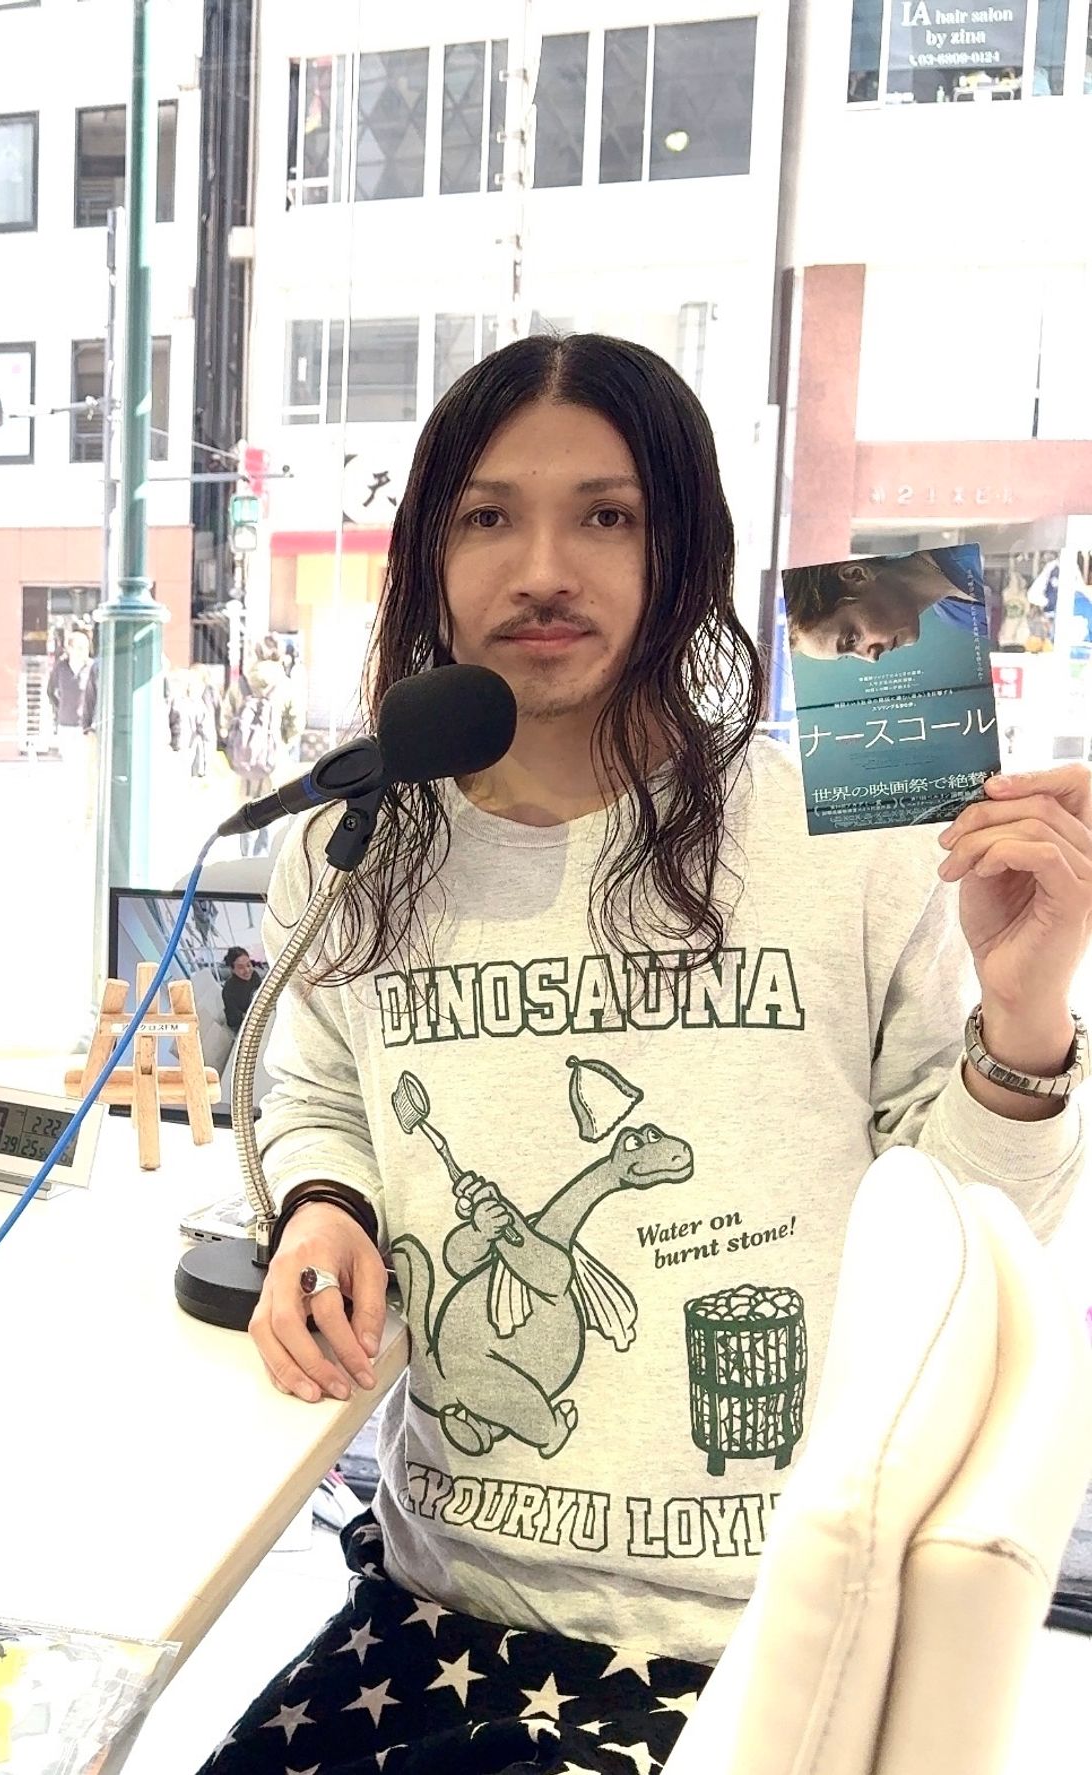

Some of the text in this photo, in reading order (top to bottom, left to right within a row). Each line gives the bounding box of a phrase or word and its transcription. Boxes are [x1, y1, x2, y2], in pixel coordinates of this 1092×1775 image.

[935, 9, 968, 25] hair
[971, 7, 1013, 22] salon
[925, 29, 947, 48] by
[799, 708, 996, 758] ナースコール
[374, 947, 805, 1048] DINOSAUNA
[636, 1211, 742, 1248] Water on
[654, 1216, 796, 1269] burnt stone!
